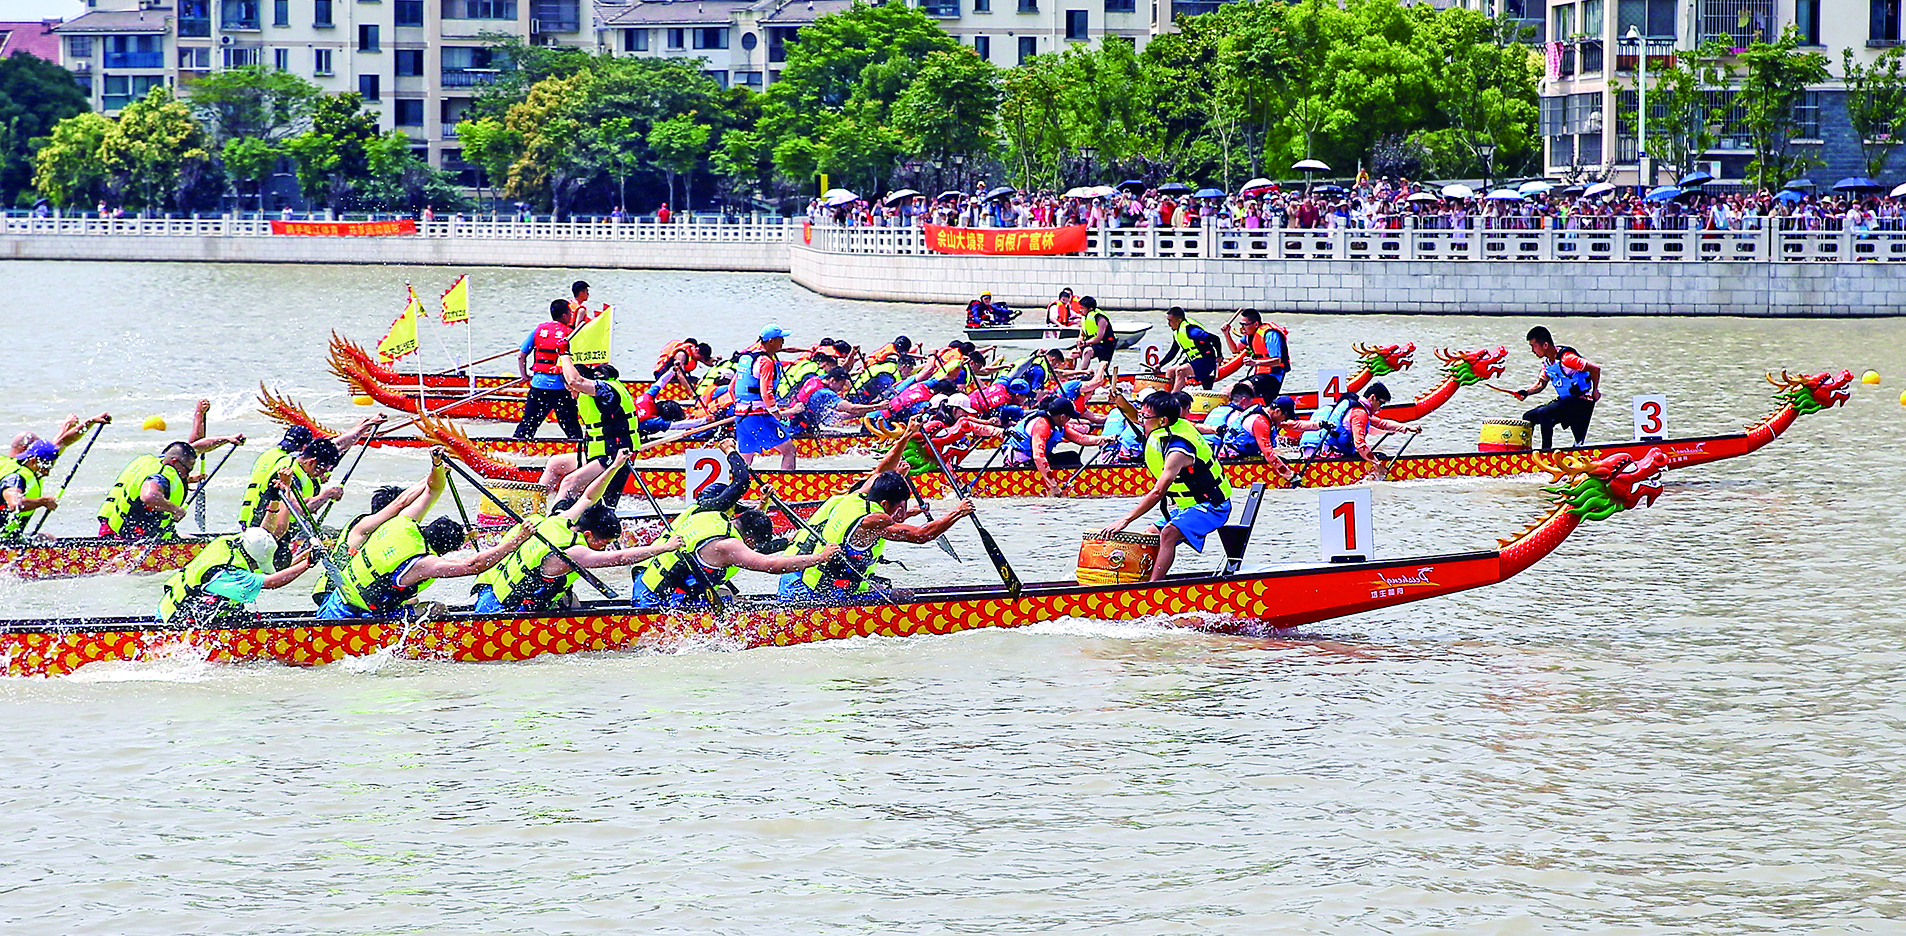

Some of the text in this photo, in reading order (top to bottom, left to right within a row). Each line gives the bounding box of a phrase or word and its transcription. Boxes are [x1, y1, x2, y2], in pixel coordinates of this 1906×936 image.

[937, 229, 1055, 252] 佘山大境界 问根广富林
[1145, 345, 1160, 367] 6
[1323, 375, 1344, 404] 4
[1641, 401, 1663, 434] 3
[693, 457, 722, 500] 2
[1333, 501, 1357, 550] 1
